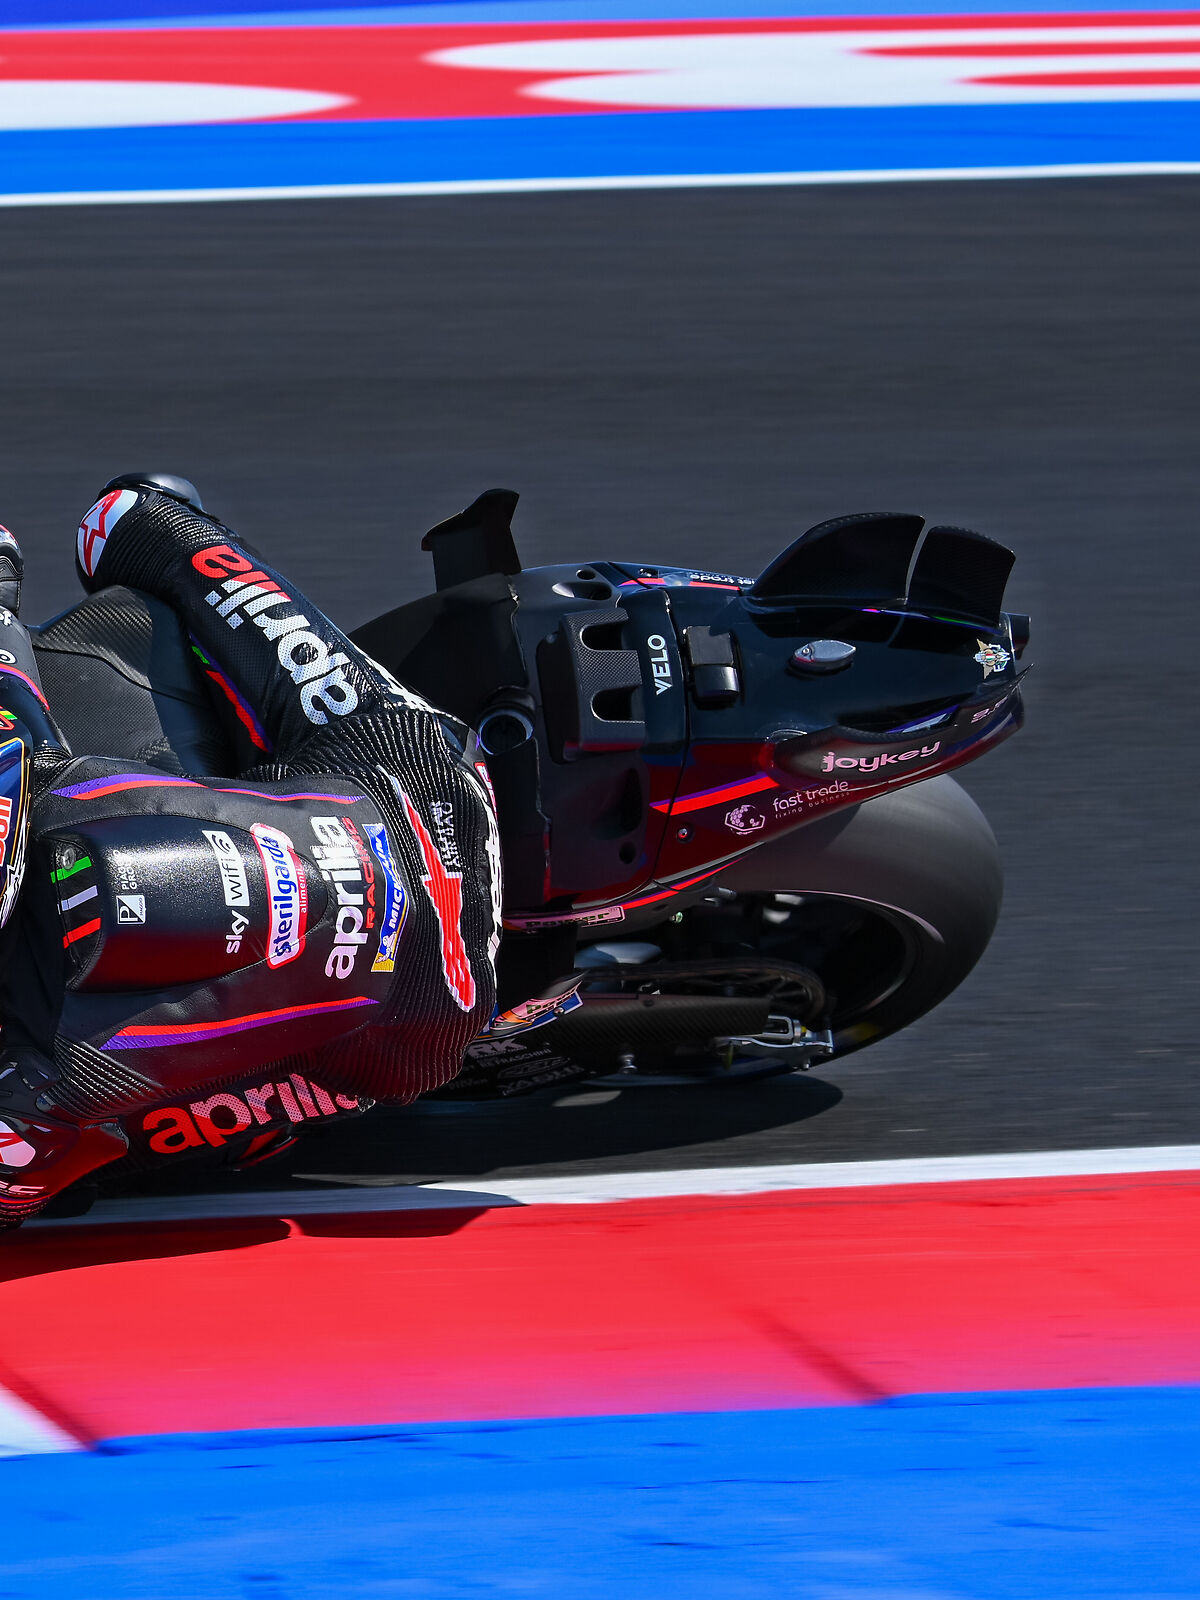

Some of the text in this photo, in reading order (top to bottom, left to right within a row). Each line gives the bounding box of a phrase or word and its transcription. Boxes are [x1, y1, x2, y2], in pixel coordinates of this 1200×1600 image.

[192, 545, 358, 725] aprilia
[647, 634, 673, 696] VELO
[772, 780, 849, 812] fast trade
[821, 741, 941, 773] joykey
[775, 791, 850, 819] fixing business
[220, 857, 250, 954] sky wifi
[261, 835, 297, 957] sterilgarda
[310, 816, 368, 980] aprilia
